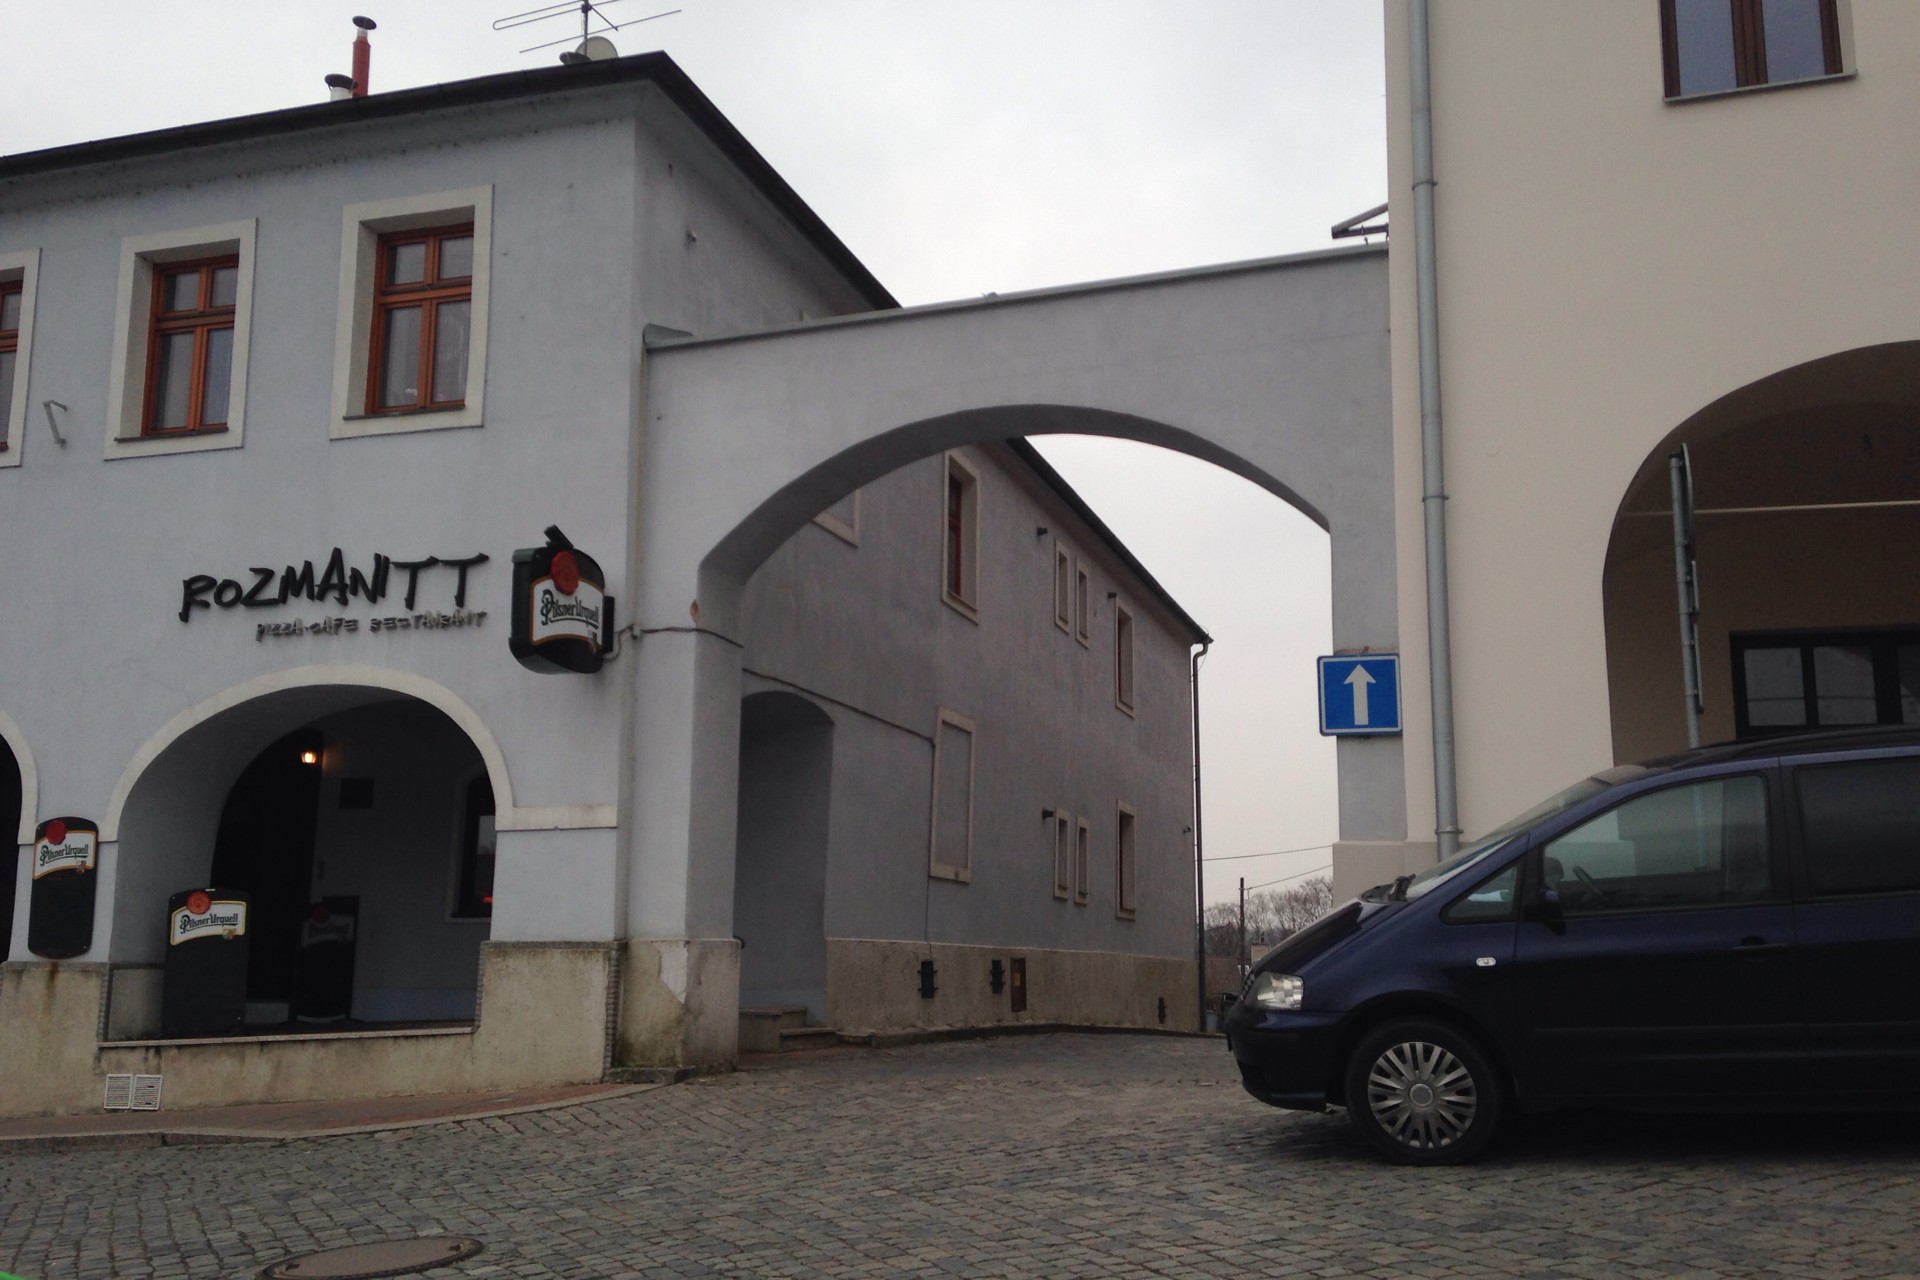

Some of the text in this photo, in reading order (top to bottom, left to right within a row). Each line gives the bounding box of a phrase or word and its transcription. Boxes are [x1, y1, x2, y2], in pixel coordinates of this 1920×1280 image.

[179, 547, 490, 623] ROZMANITT
[541, 589, 599, 627] Pilsner Urquell
[40, 843, 89, 866] Pilsner Urquell
[180, 913, 239, 934] Pilsner Urquell
